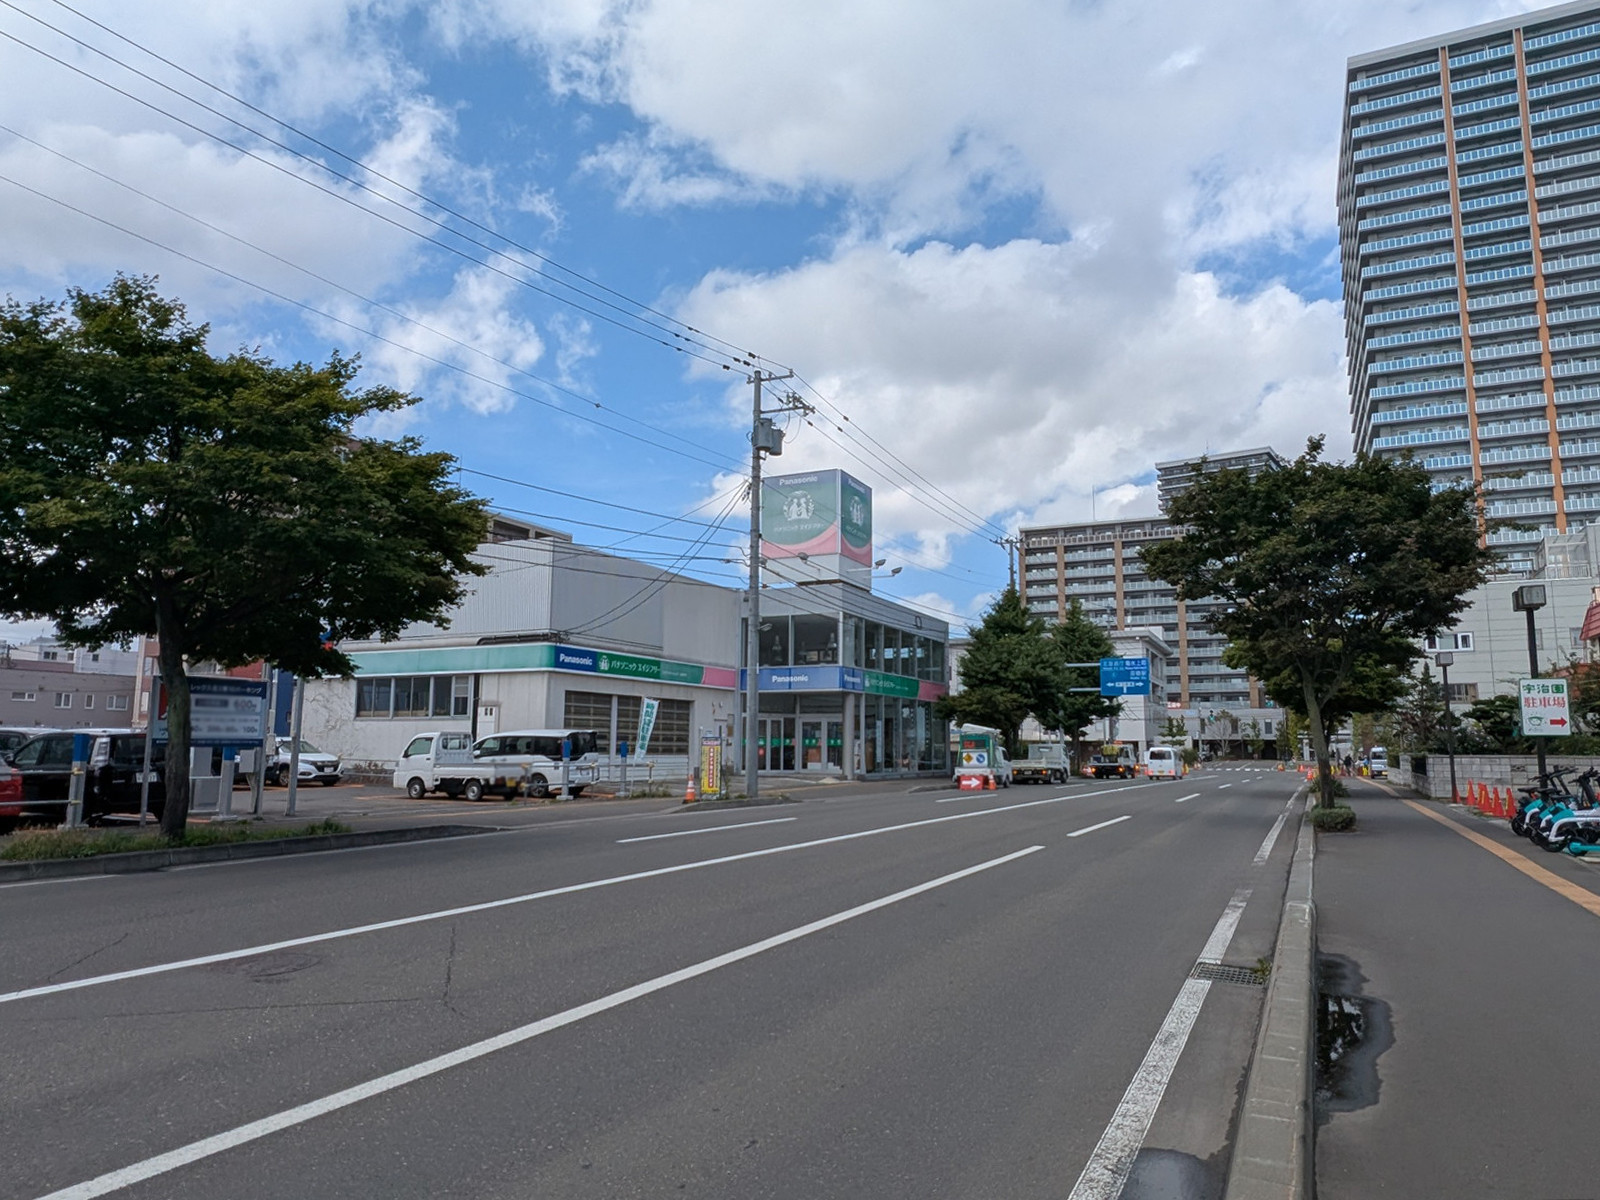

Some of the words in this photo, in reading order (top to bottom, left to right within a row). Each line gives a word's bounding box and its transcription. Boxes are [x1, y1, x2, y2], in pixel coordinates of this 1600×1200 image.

[779, 476, 818, 485] Panasonic
[559, 653, 593, 666] Panasonic
[772, 674, 809, 683] Panasonic
[1524, 696, 1566, 708] 駐車場
